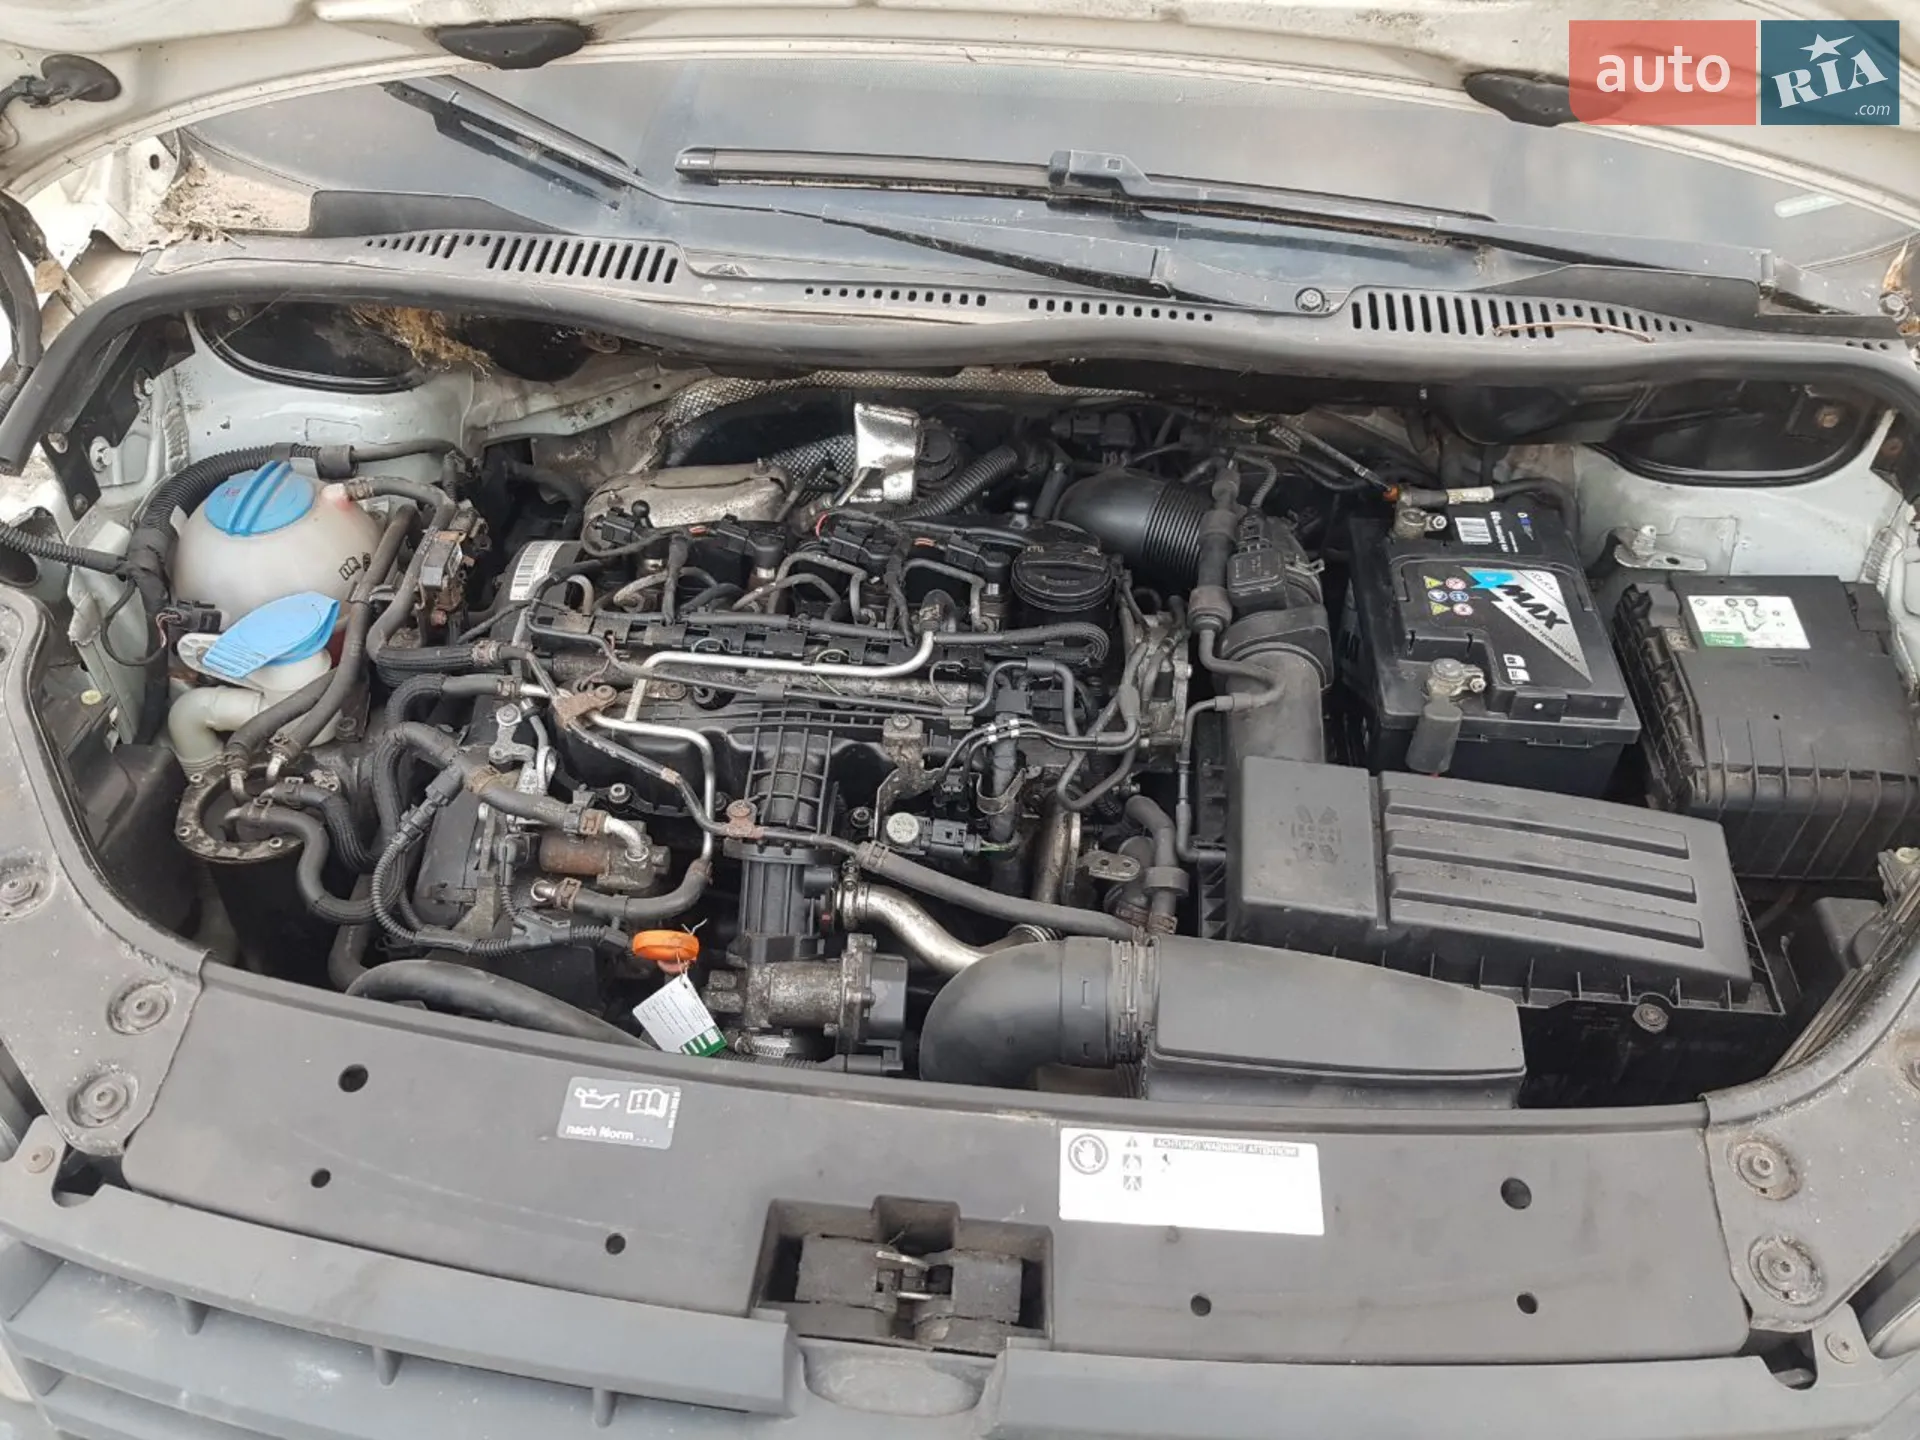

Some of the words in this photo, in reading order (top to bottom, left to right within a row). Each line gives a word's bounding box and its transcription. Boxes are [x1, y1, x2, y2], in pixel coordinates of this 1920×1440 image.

[1496, 584, 1569, 630] MAX
[565, 1124, 597, 1137] nach
[598, 1126, 634, 1141] Norm
